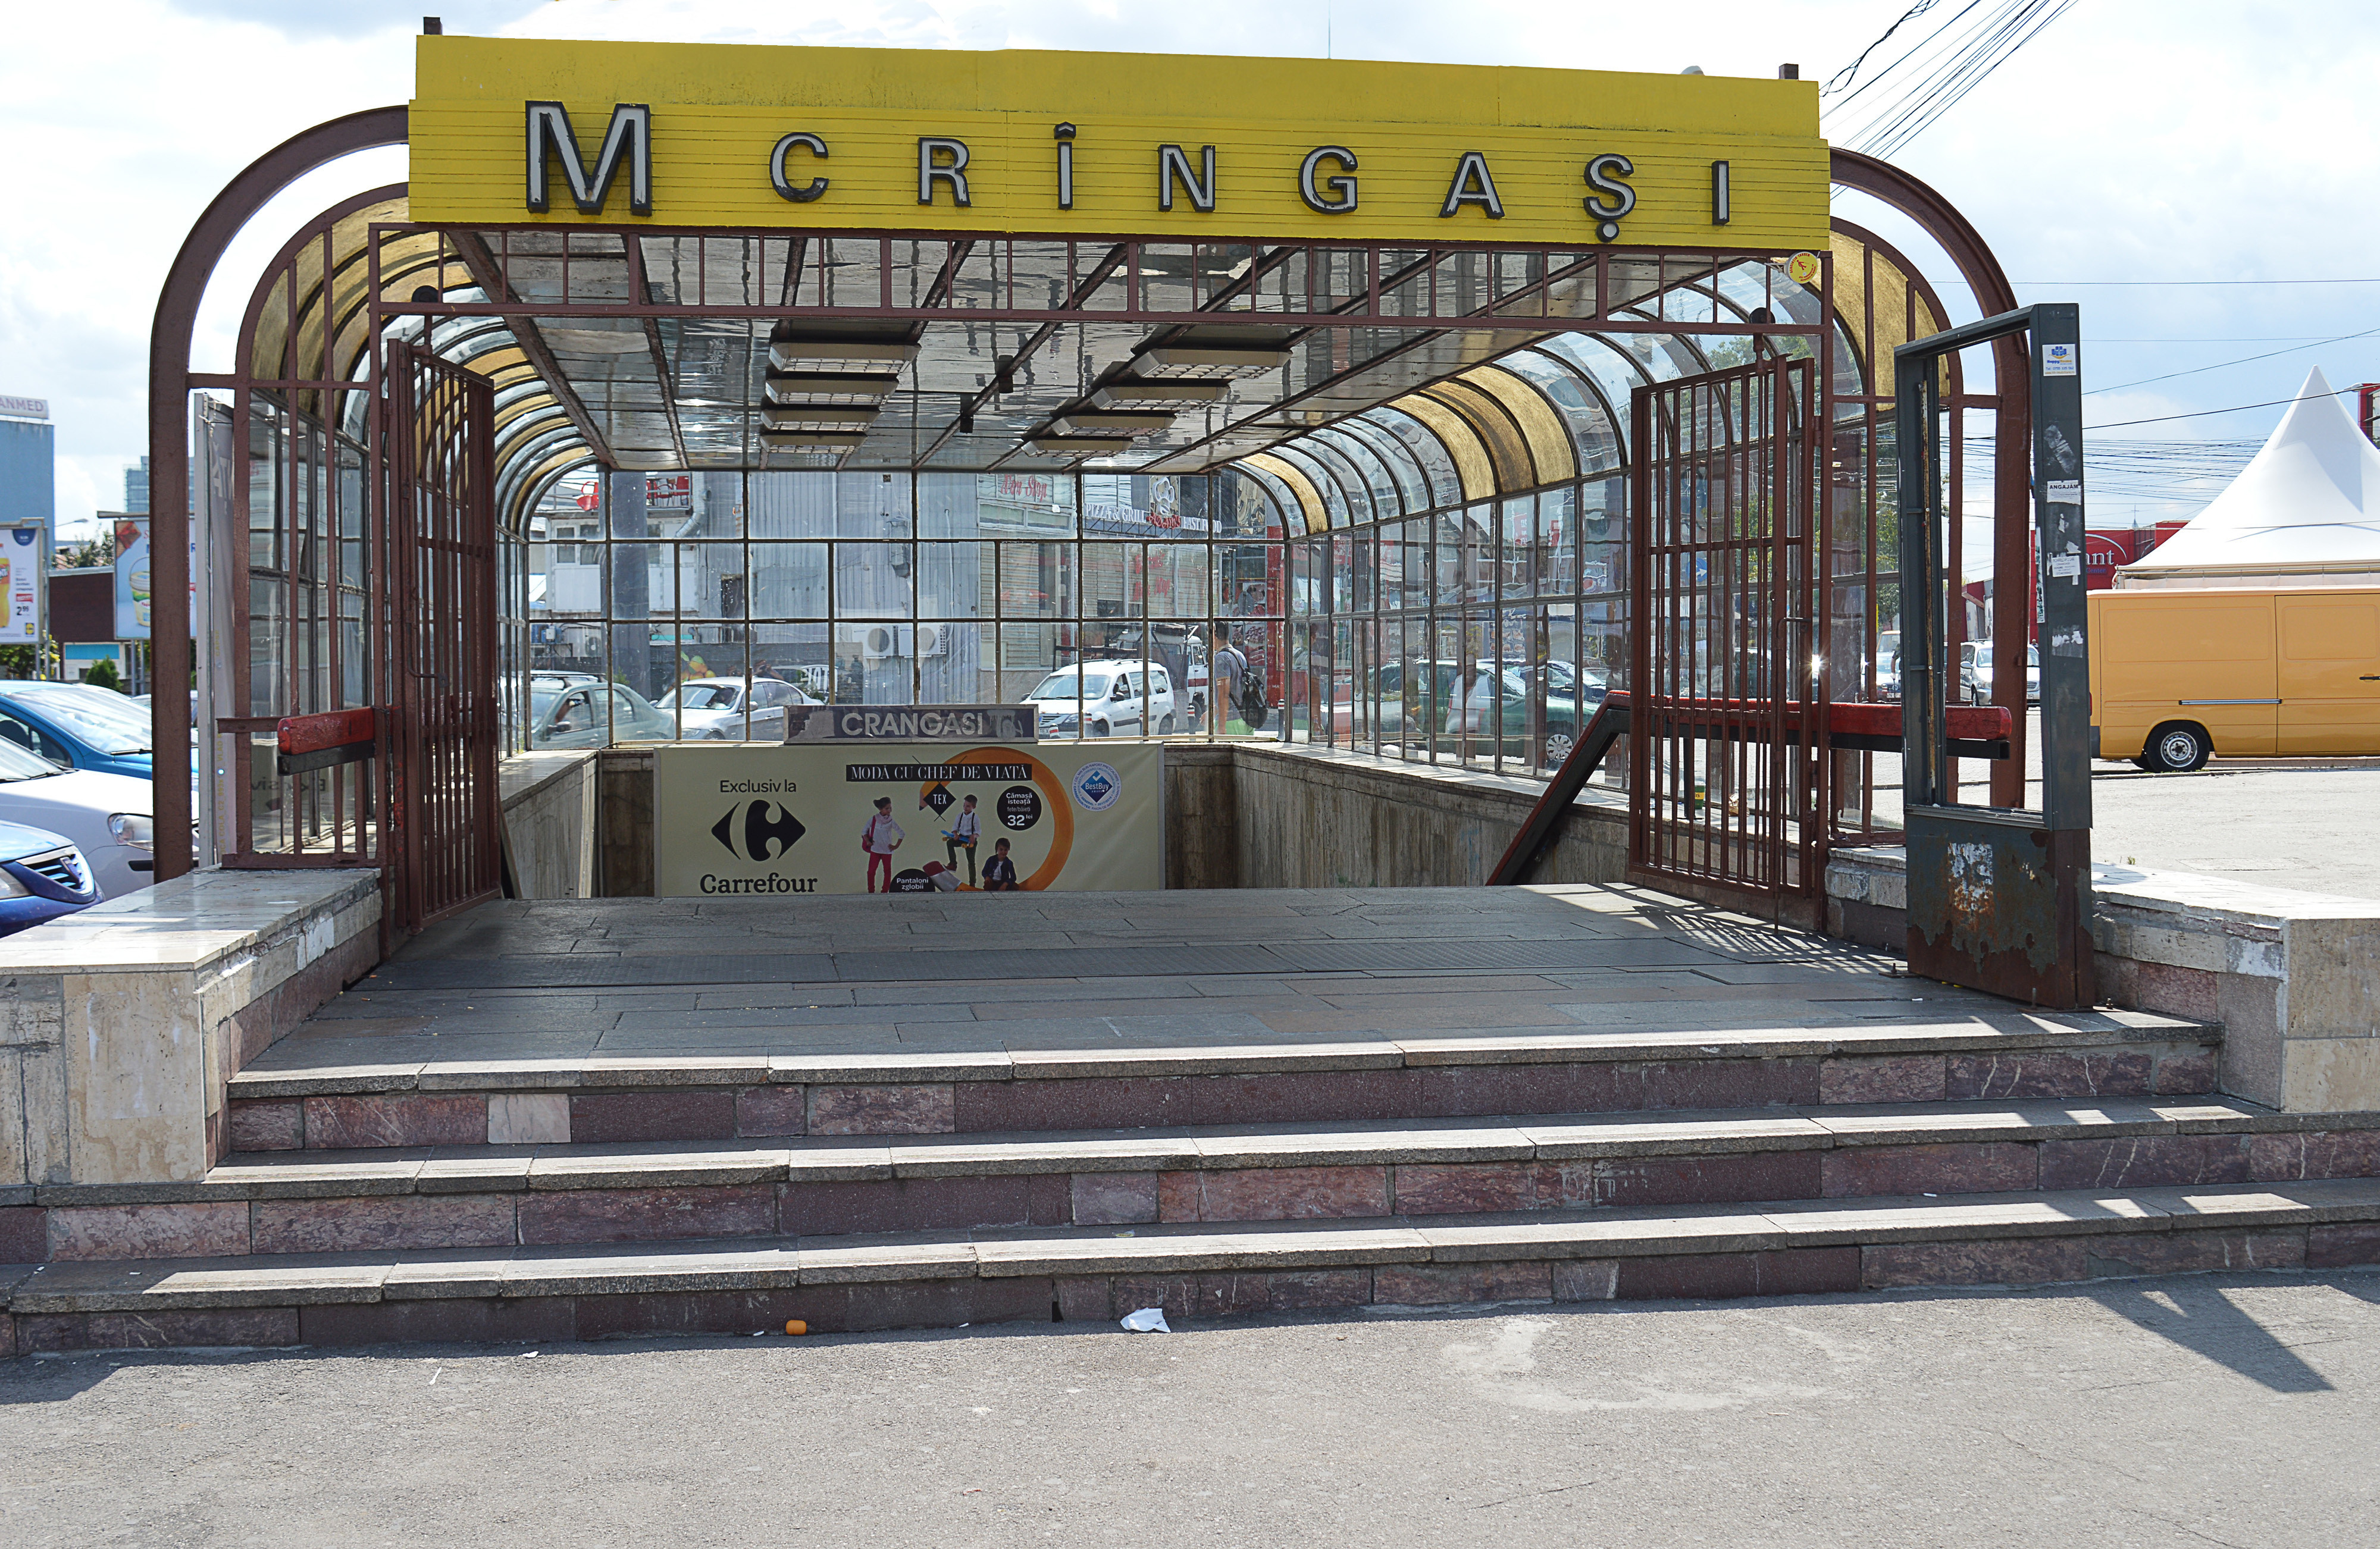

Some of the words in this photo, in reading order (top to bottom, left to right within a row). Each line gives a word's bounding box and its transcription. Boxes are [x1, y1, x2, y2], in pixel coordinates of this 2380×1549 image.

[525, 101, 652, 216] M
[1085, 503, 1111, 519] PIZZA
[1122, 509, 1147, 523] GRILL
[1183, 517, 1201, 531] FAST
[841, 713, 983, 736] CRANGASI
[851, 765, 890, 779] MODĂ
[894, 766, 913, 779] CU
[918, 766, 957, 779] CHEF
[962, 766, 980, 779] DE
[720, 779, 781, 792] Exclusiv
[784, 779, 797, 792] la
[933, 794, 947, 804] TEX
[1007, 814, 1025, 826] 32
[700, 872, 818, 893] Carrefour
